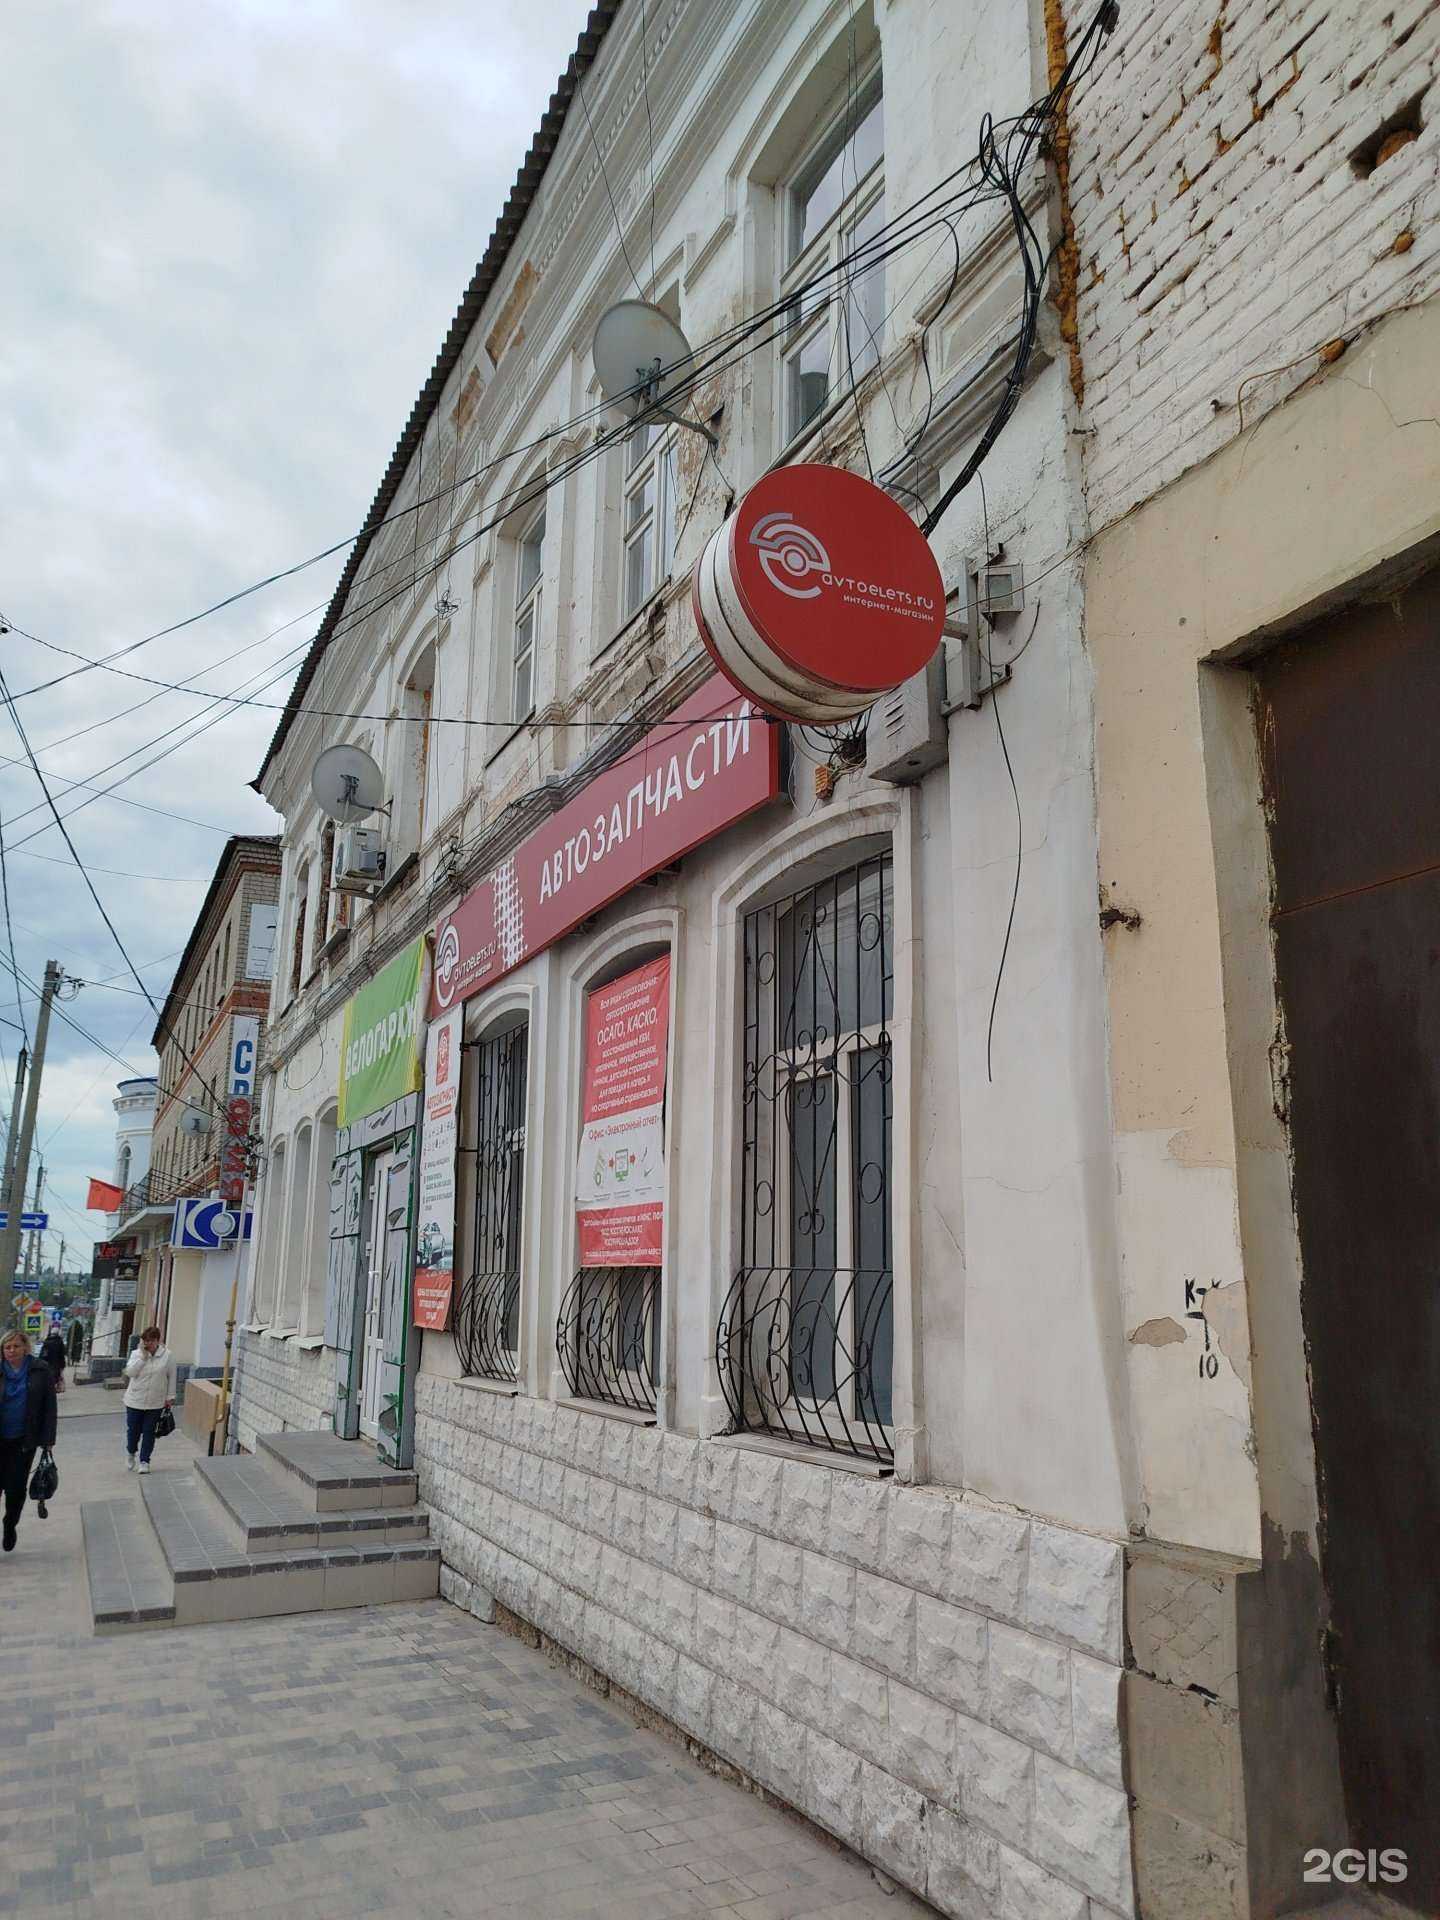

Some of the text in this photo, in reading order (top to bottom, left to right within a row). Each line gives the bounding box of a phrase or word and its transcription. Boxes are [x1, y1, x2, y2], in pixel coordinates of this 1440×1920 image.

[843, 594, 935, 623] интернет-магазин
[539, 699, 750, 905] АВТОЗАПЧАСТИ
[597, 1007, 658, 1046] ОСАГО, КАСКО,
